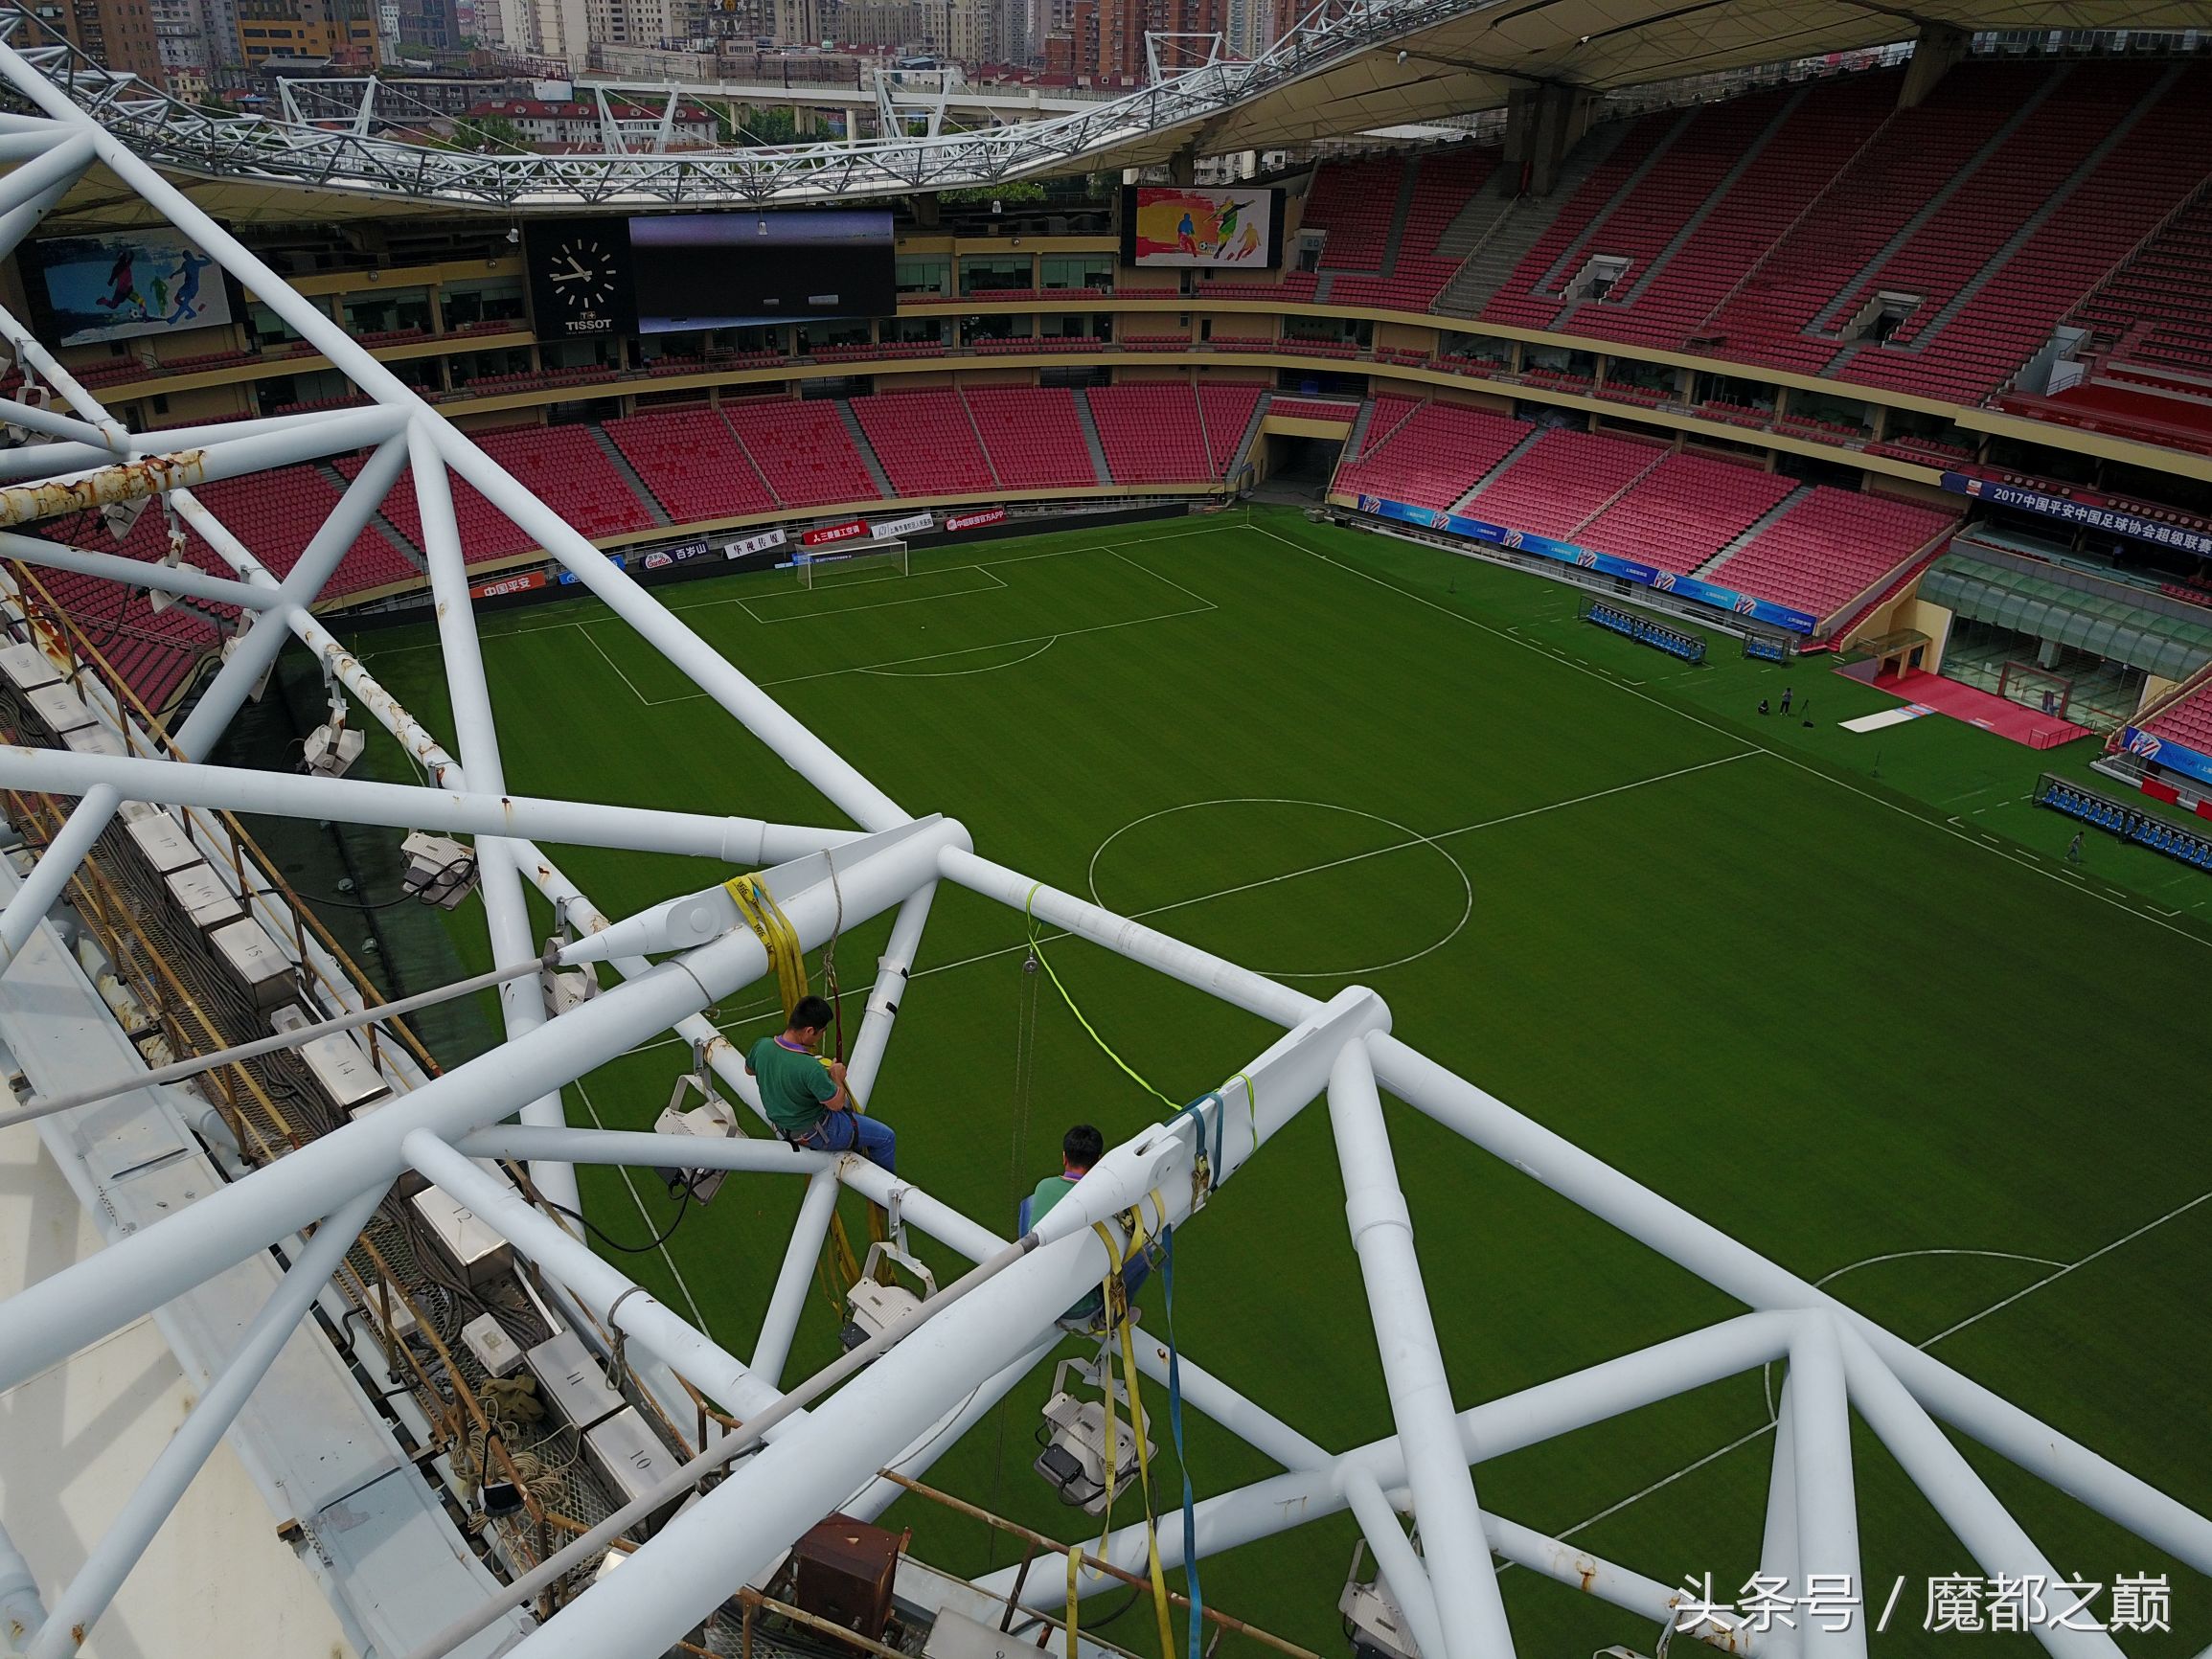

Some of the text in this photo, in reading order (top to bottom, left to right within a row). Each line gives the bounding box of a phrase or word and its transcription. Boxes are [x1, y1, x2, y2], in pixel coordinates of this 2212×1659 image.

[710, 19, 741, 31] KTV
[565, 319, 612, 330] TISSOT
[675, 543, 707, 560] 百岁山
[484, 577, 531, 596] 中国平安
[159, 837, 177, 848] 17
[244, 944, 262, 958] 15
[452, 1206, 472, 1223] 12
[566, 1371, 584, 1386] 11
[630, 1449, 651, 1469] 10
